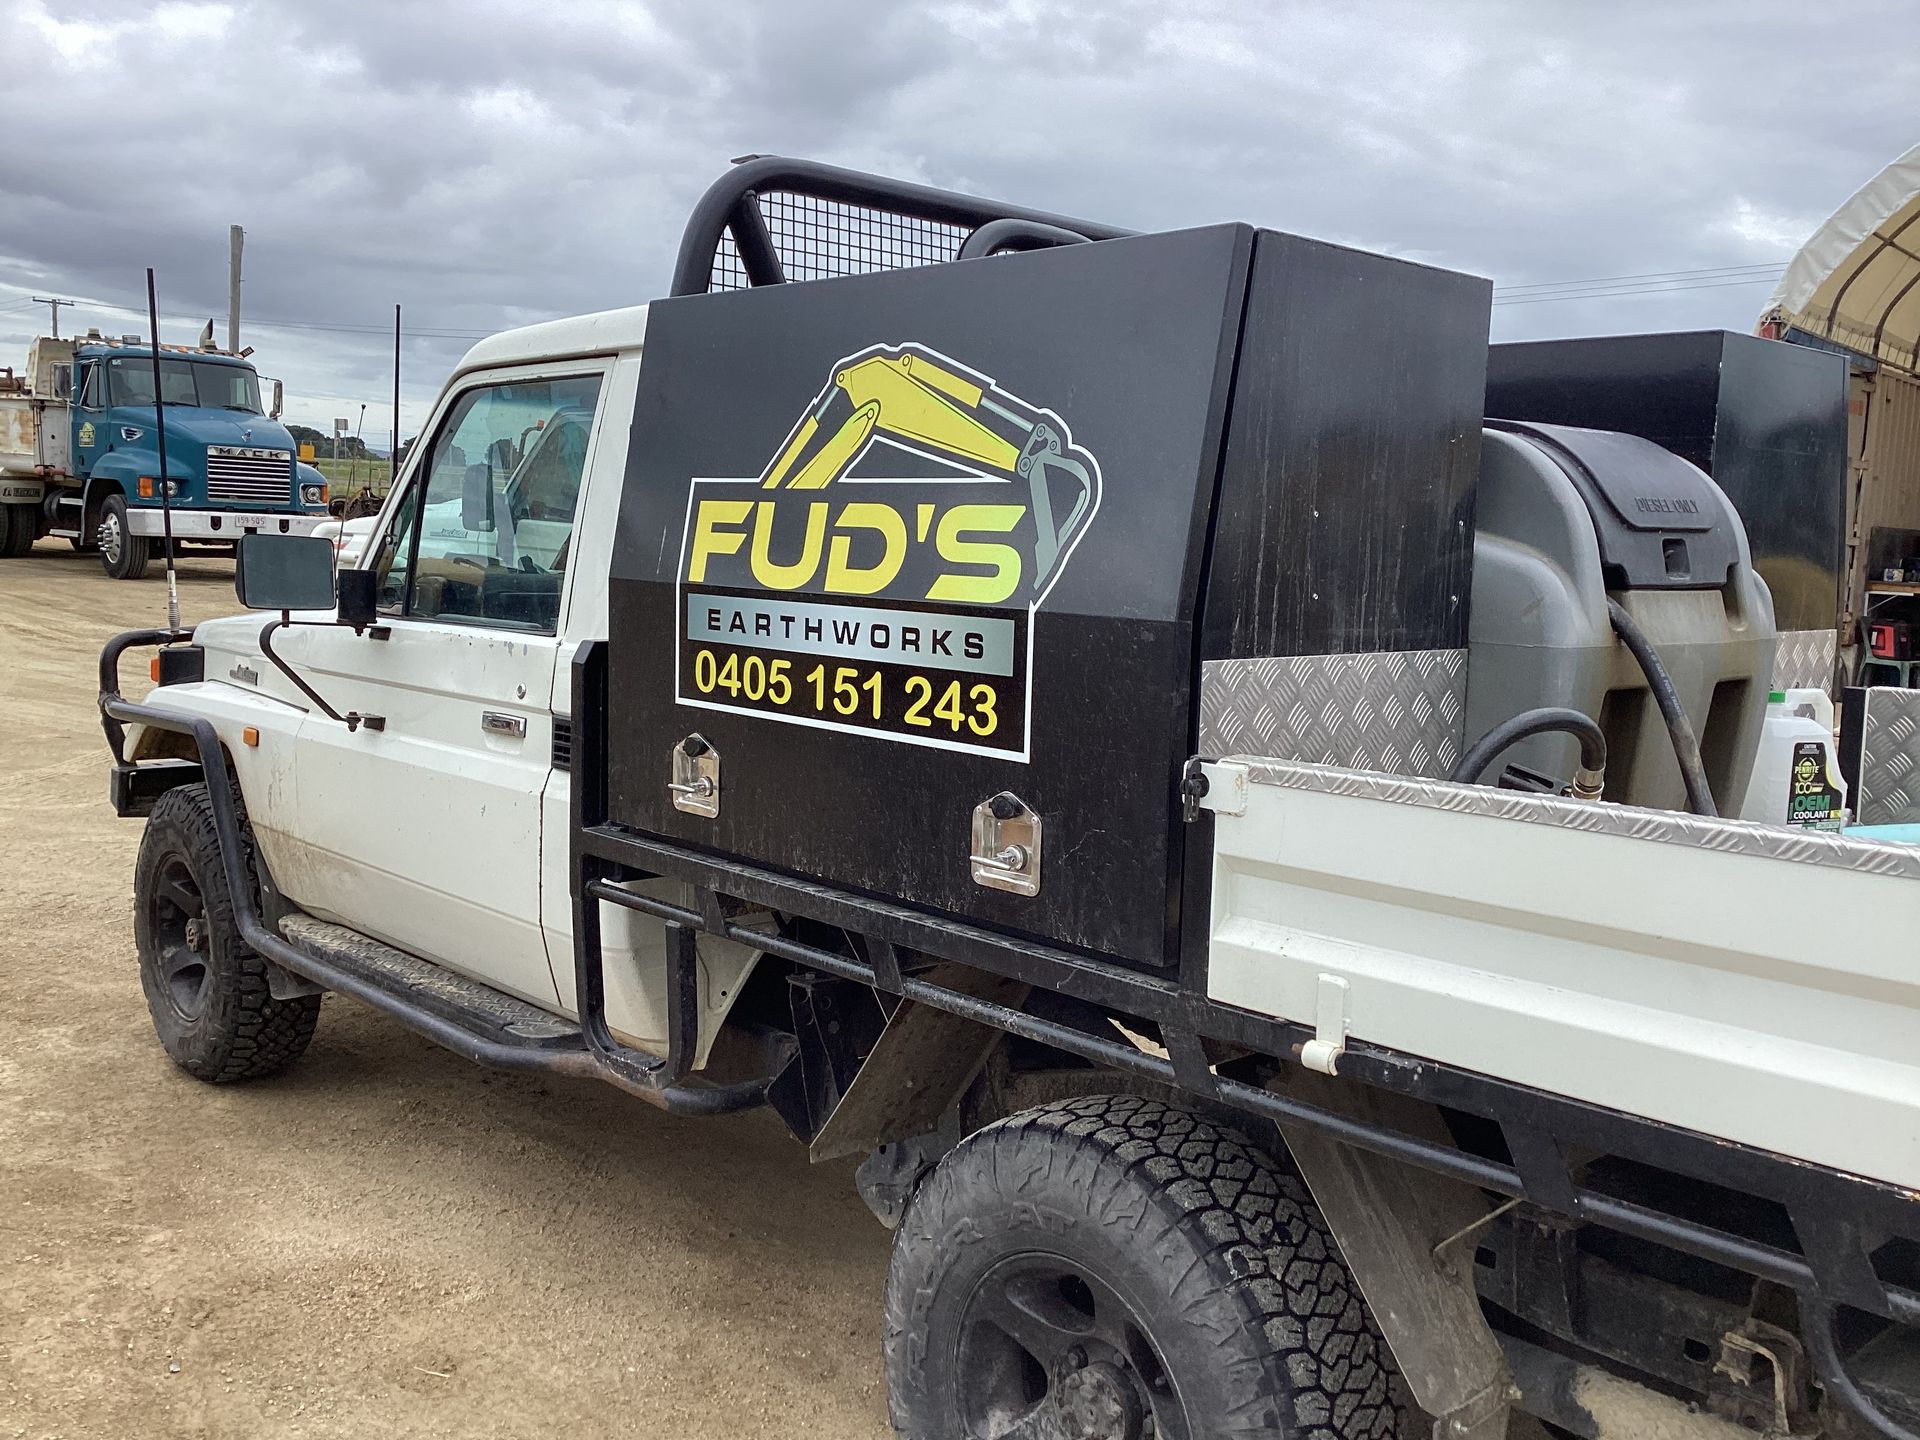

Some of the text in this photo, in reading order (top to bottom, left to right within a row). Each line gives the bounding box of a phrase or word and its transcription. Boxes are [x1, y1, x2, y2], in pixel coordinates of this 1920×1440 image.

[220, 448, 280, 458] MACK
[1634, 497, 1699, 513] DIESEL ONLY
[687, 500, 1027, 603] FUD'S
[707, 608, 985, 659] EARTHWORKS
[695, 649, 999, 737] 0405 151 243
[1795, 782, 1811, 794] 100
[1795, 795, 1830, 811] OEM
[1793, 810, 1829, 819] COOLANT
